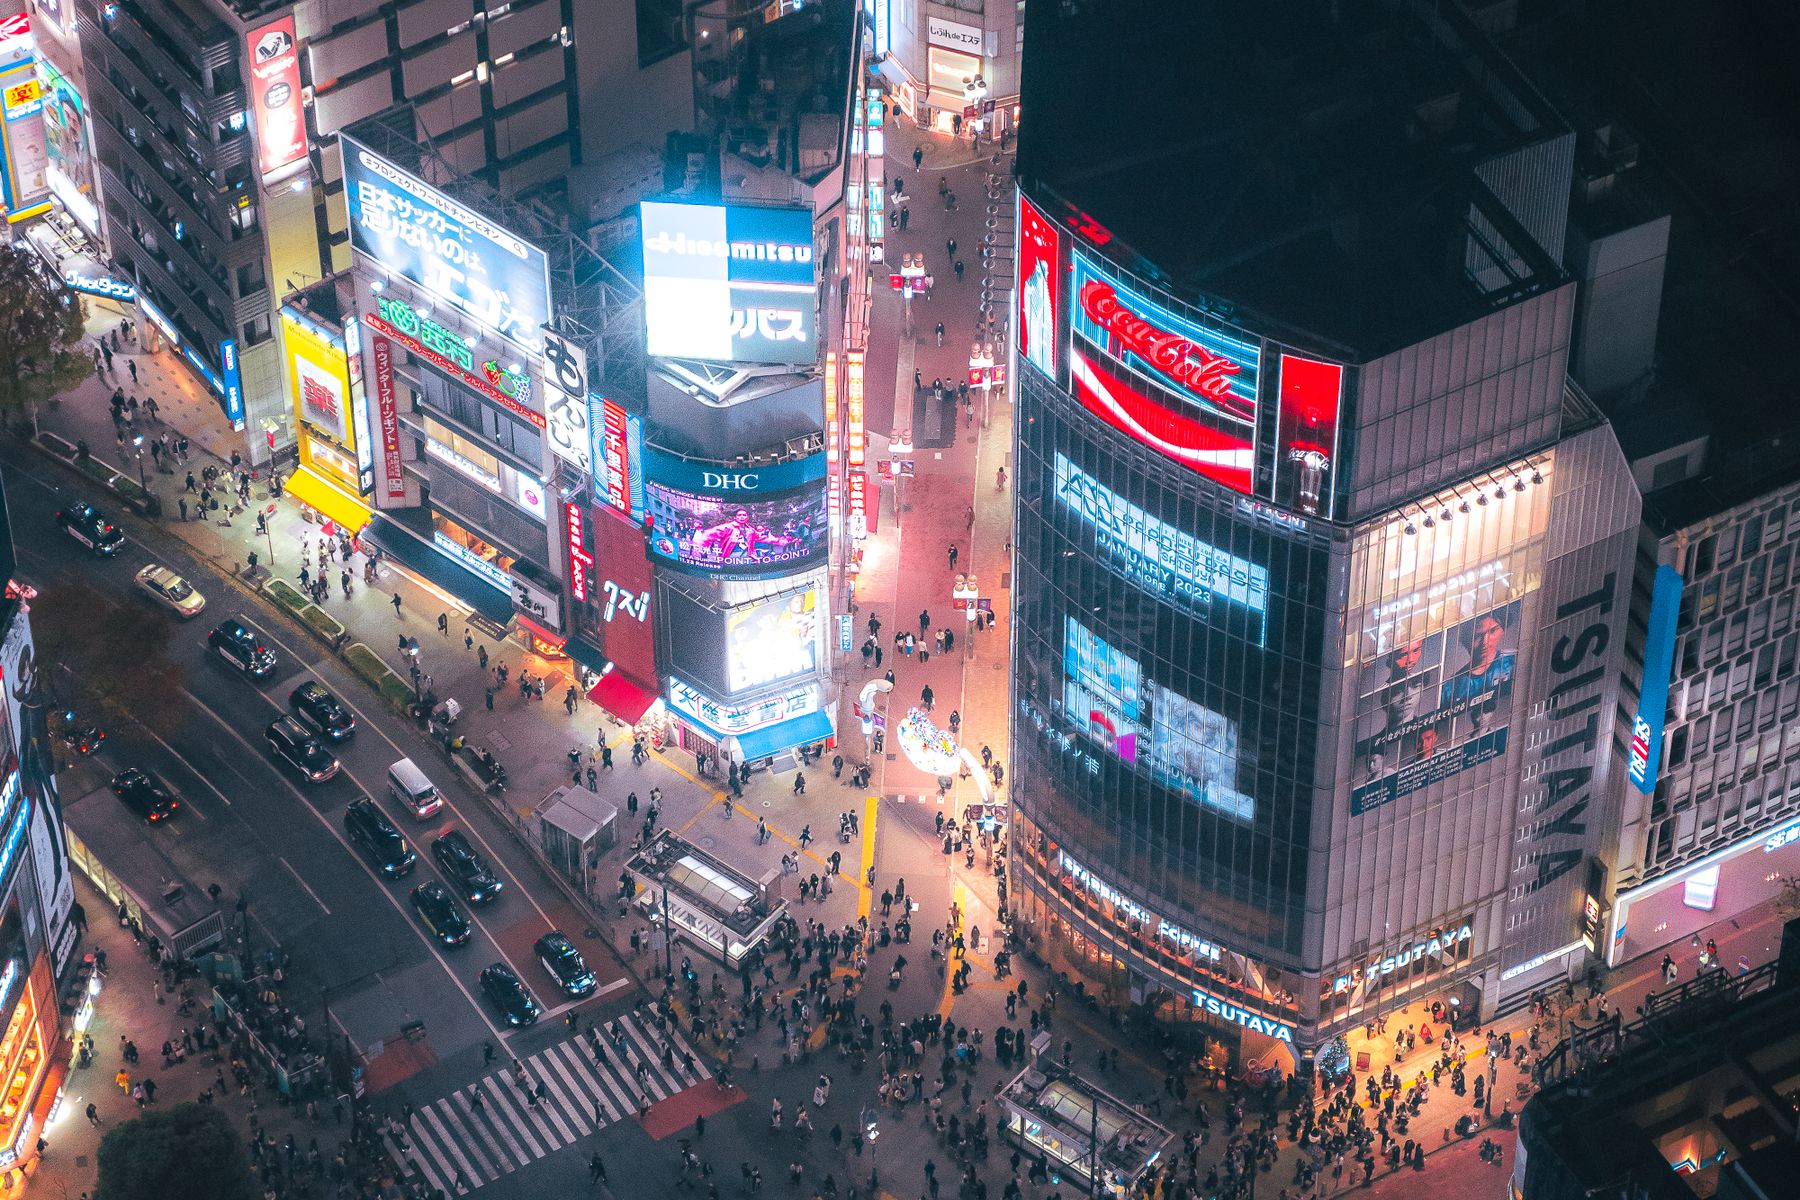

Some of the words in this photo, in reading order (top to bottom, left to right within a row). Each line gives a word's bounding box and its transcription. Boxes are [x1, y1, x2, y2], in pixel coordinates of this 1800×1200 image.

[357, 180, 473, 244] 日本サッカーに
[420, 322, 473, 371] 西村
[1080, 279, 1242, 403] Coca-Cola
[544, 335, 589, 468] もんじゃ
[702, 471, 759, 490] DHC
[1098, 535, 1170, 582] JANUARY
[1176, 579, 1212, 604] 2023
[1398, 756, 1439, 778] SAMURAI
[1439, 748, 1463, 765] BLUE
[1525, 570, 1618, 894] TSUTAYA
[1628, 714, 1651, 784] SEIBU
[1064, 858, 1151, 925] STARBUCKS
[1158, 922, 1221, 961] COFFEE
[1367, 925, 1473, 980] TSUTAYA
[1192, 990, 1292, 1043] TSUTAYA
